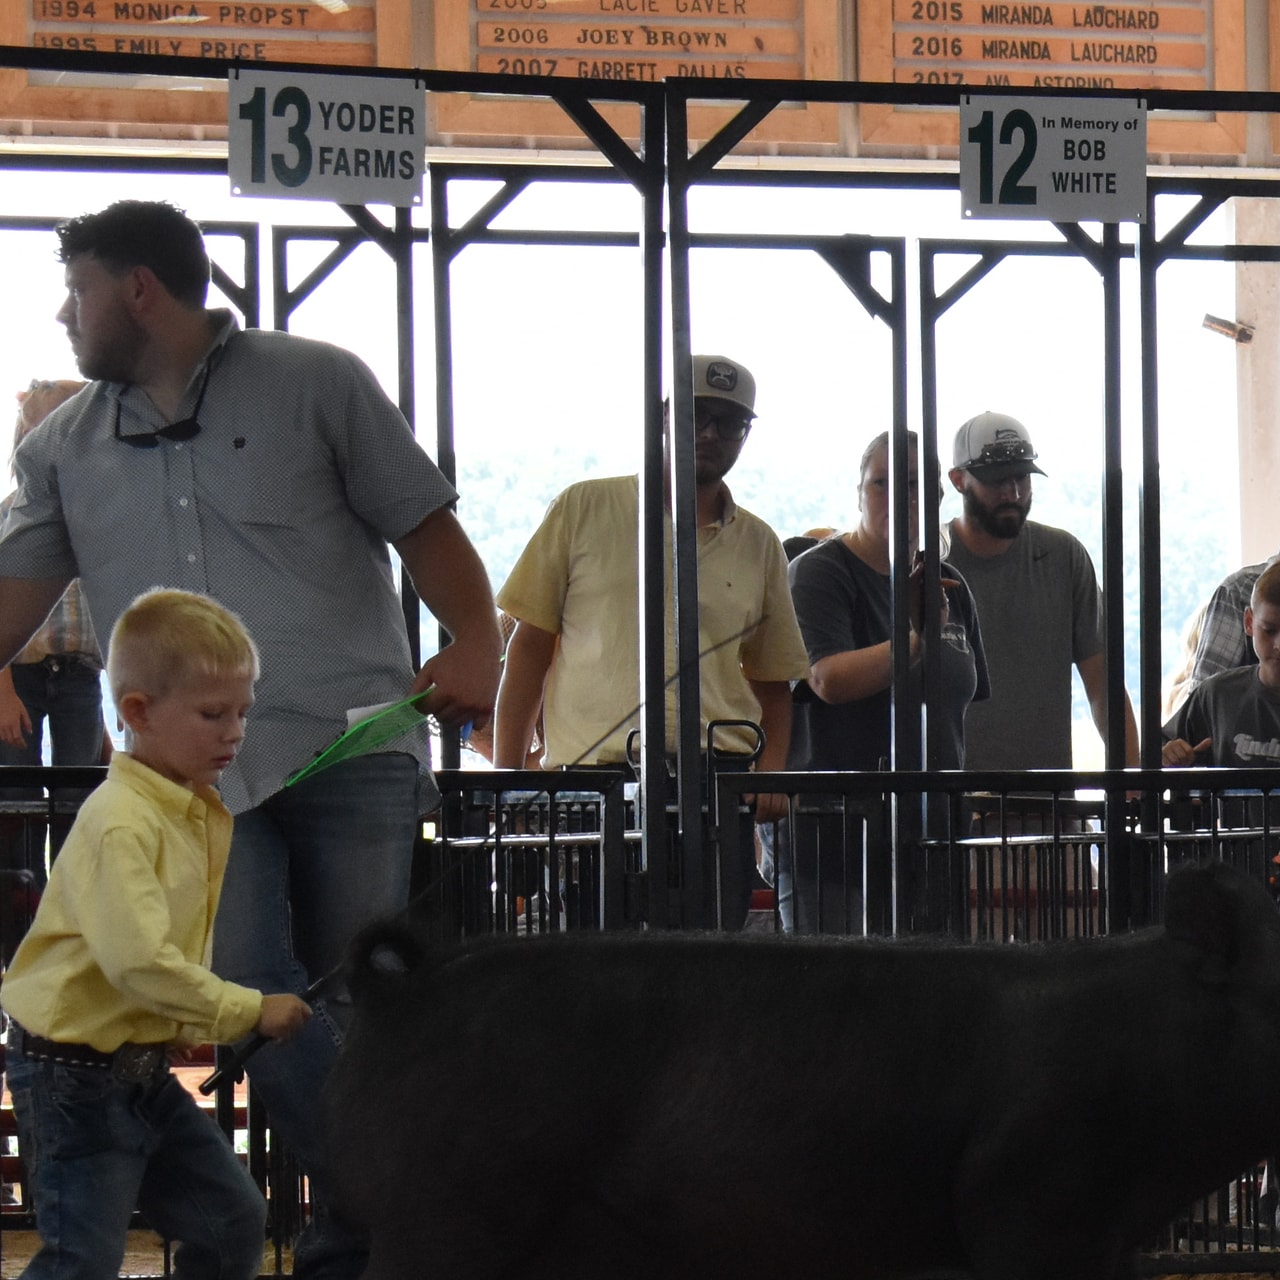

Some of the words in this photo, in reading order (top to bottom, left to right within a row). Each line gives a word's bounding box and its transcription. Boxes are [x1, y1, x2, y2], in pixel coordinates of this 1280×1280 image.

[40, 0, 97, 18] 1994
[113, 2, 199, 21] MONICA
[218, 5, 310, 26] PROPST
[599, 0, 660, 13] LACIE
[675, 0, 746, 14] GAVER
[911, 1, 963, 22] 2015
[981, 5, 1053, 26] MIRANDA
[1072, 7, 1160, 30] LAUCHARD
[41, 36, 98, 52] 1995
[113, 39, 183, 56] EMILY
[200, 41, 267, 61] PRICE
[493, 27, 549, 44] 2006
[577, 29, 635, 45] JOEY
[646, 31, 728, 48] BROWN
[911, 36, 963, 57] 2016
[981, 39, 1052, 61] MIRANDA
[1070, 42, 1158, 65] LAUCHARD
[497, 58, 558, 78] 2007
[577, 61, 657, 83] GARRETT
[678, 63, 746, 80] DALLAS
[913, 71, 965, 86] 2017
[985, 74, 1011, 87] AVA
[318, 101, 415, 135] YODER
[1042, 116, 1055, 129] In
[1060, 117, 1119, 133] Memory
[1123, 118, 1139, 131] of
[239, 86, 313, 188] 13
[967, 108, 1038, 205] 12
[1063, 139, 1106, 161] BOB
[318, 146, 415, 180] FARMS
[1052, 171, 1117, 194] WHITE
